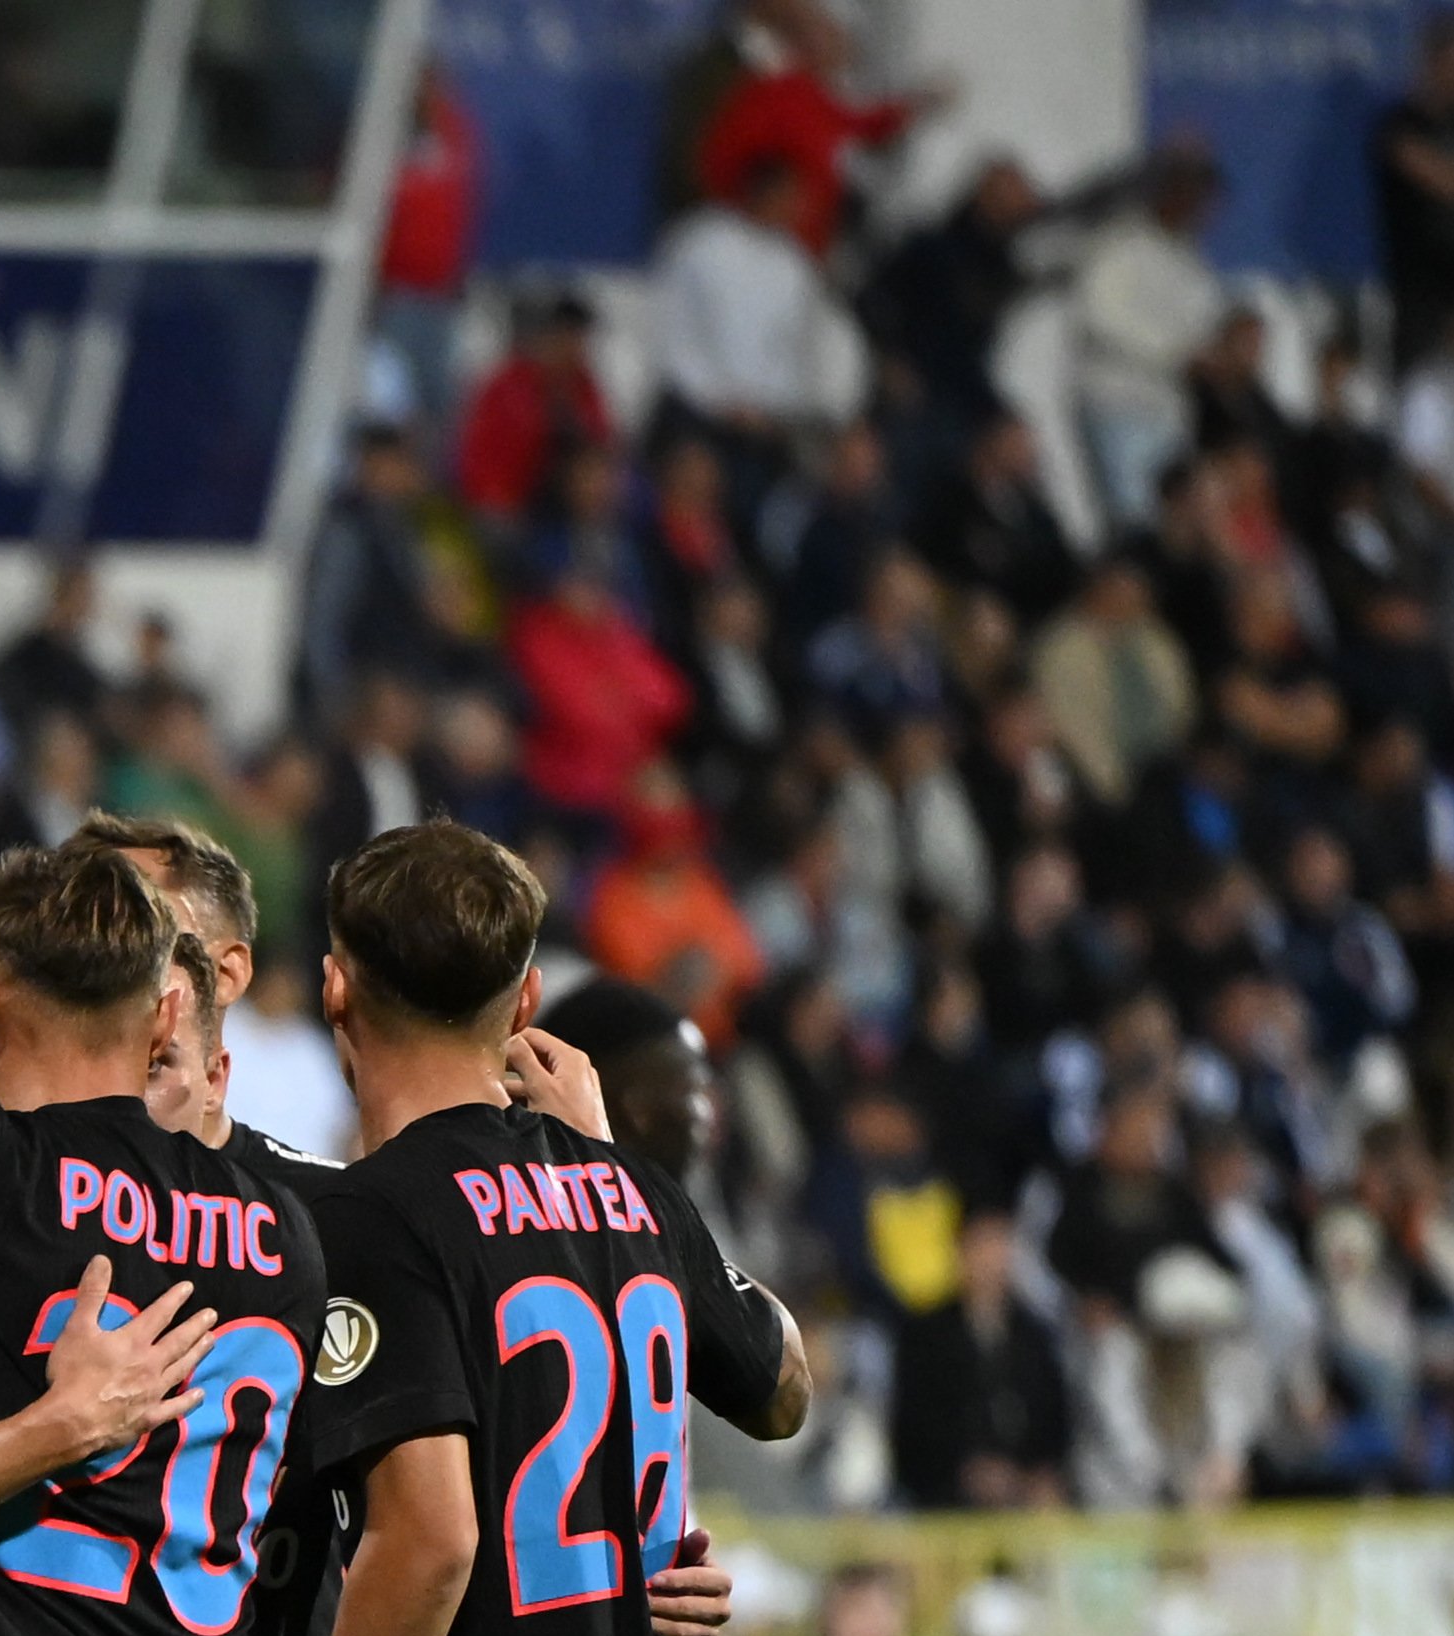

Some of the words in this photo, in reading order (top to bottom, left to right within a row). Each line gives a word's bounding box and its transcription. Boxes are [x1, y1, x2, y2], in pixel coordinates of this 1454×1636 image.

[59, 1156, 283, 1277] POLITIC
[453, 1162, 660, 1236] PANTEA
[494, 1273, 690, 1617] 28
